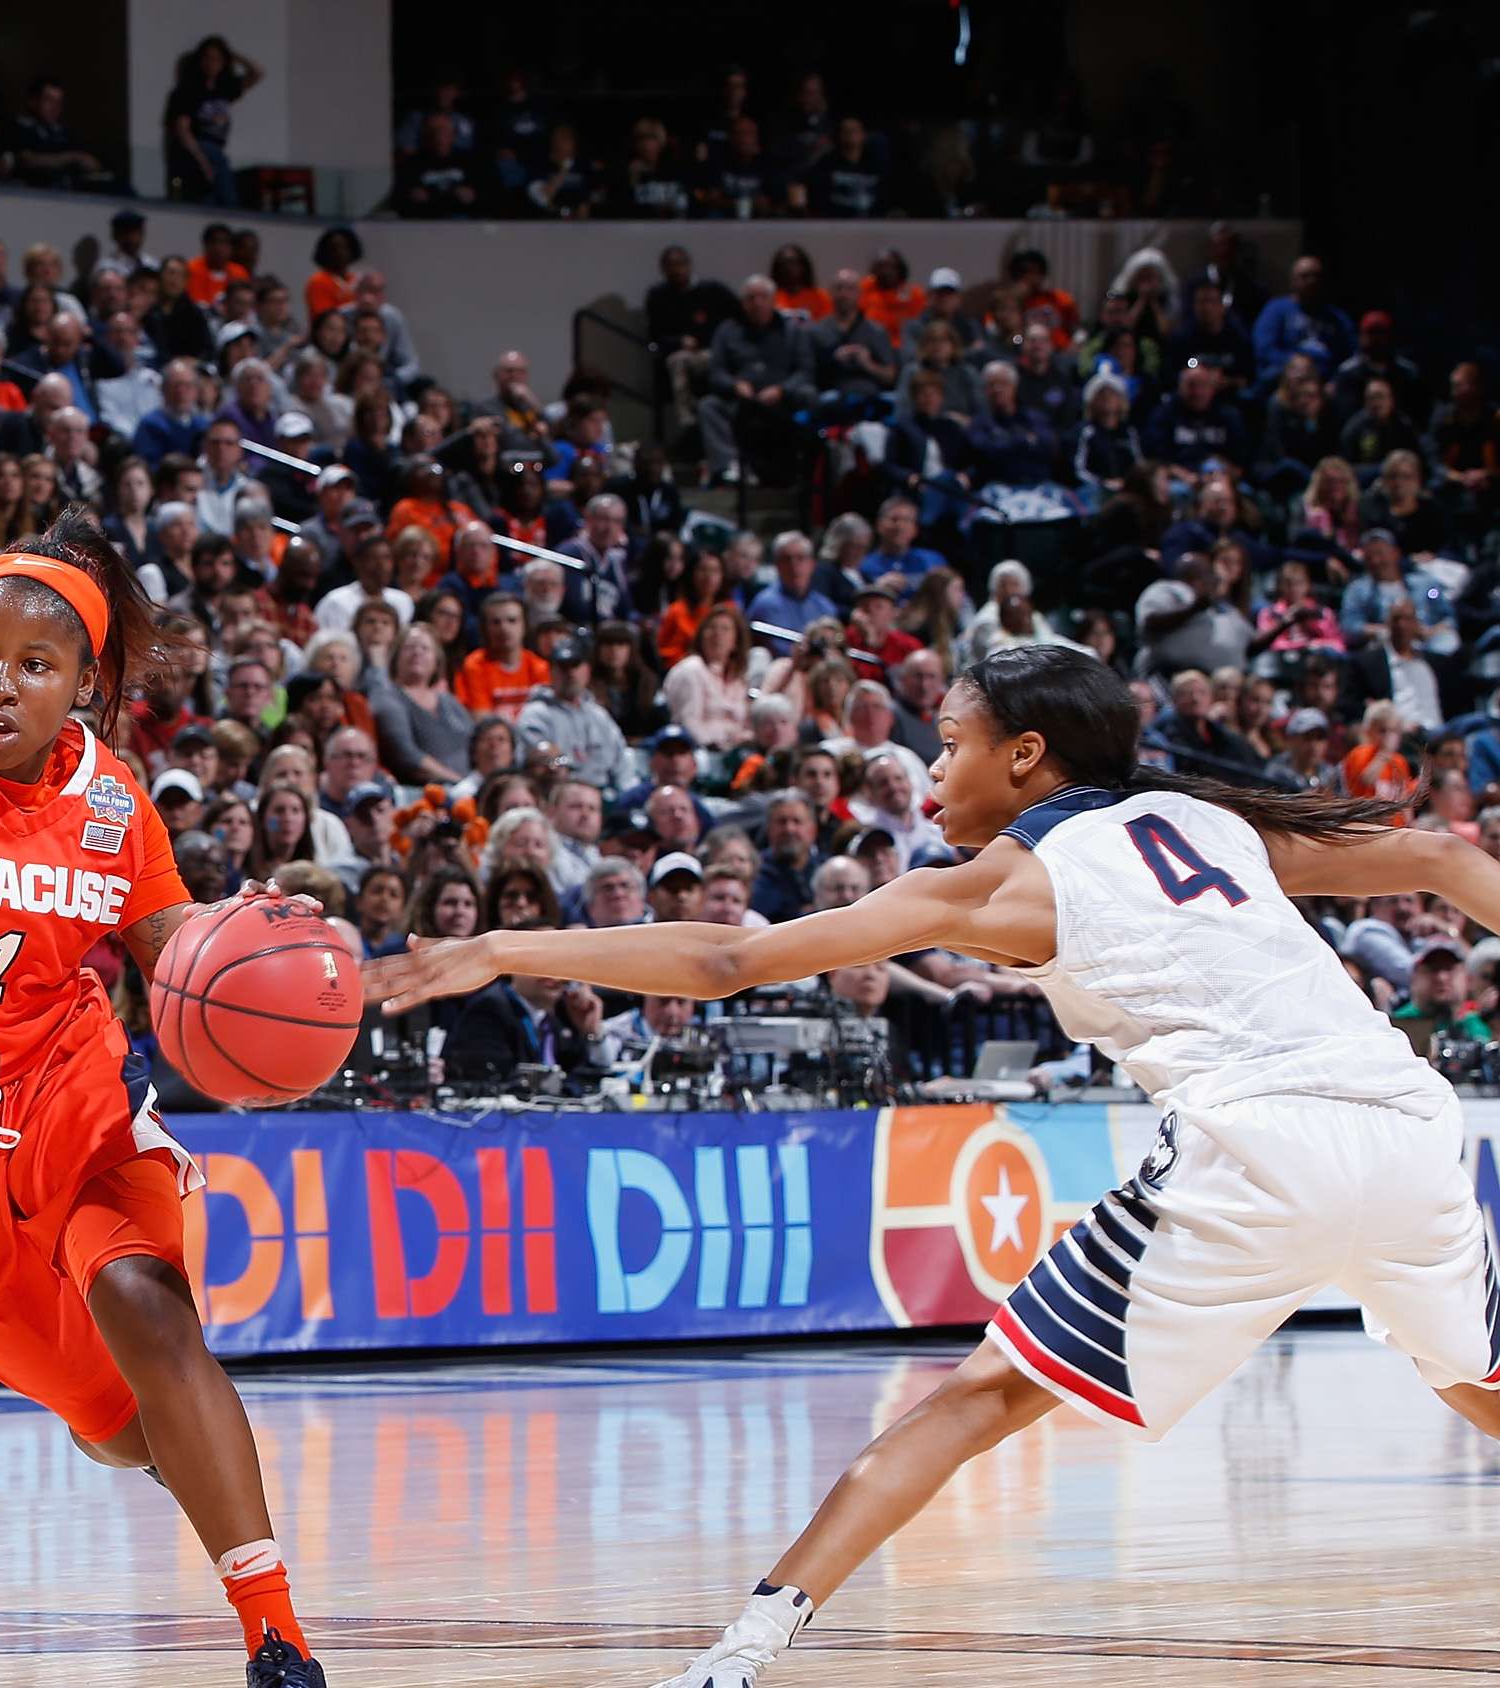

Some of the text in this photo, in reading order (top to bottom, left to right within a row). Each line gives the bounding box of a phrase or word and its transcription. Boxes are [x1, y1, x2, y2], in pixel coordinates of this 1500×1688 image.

[1124, 812, 1252, 908] 4
[365, 1147, 558, 1318] DII
[587, 1144, 812, 1313] DIII
